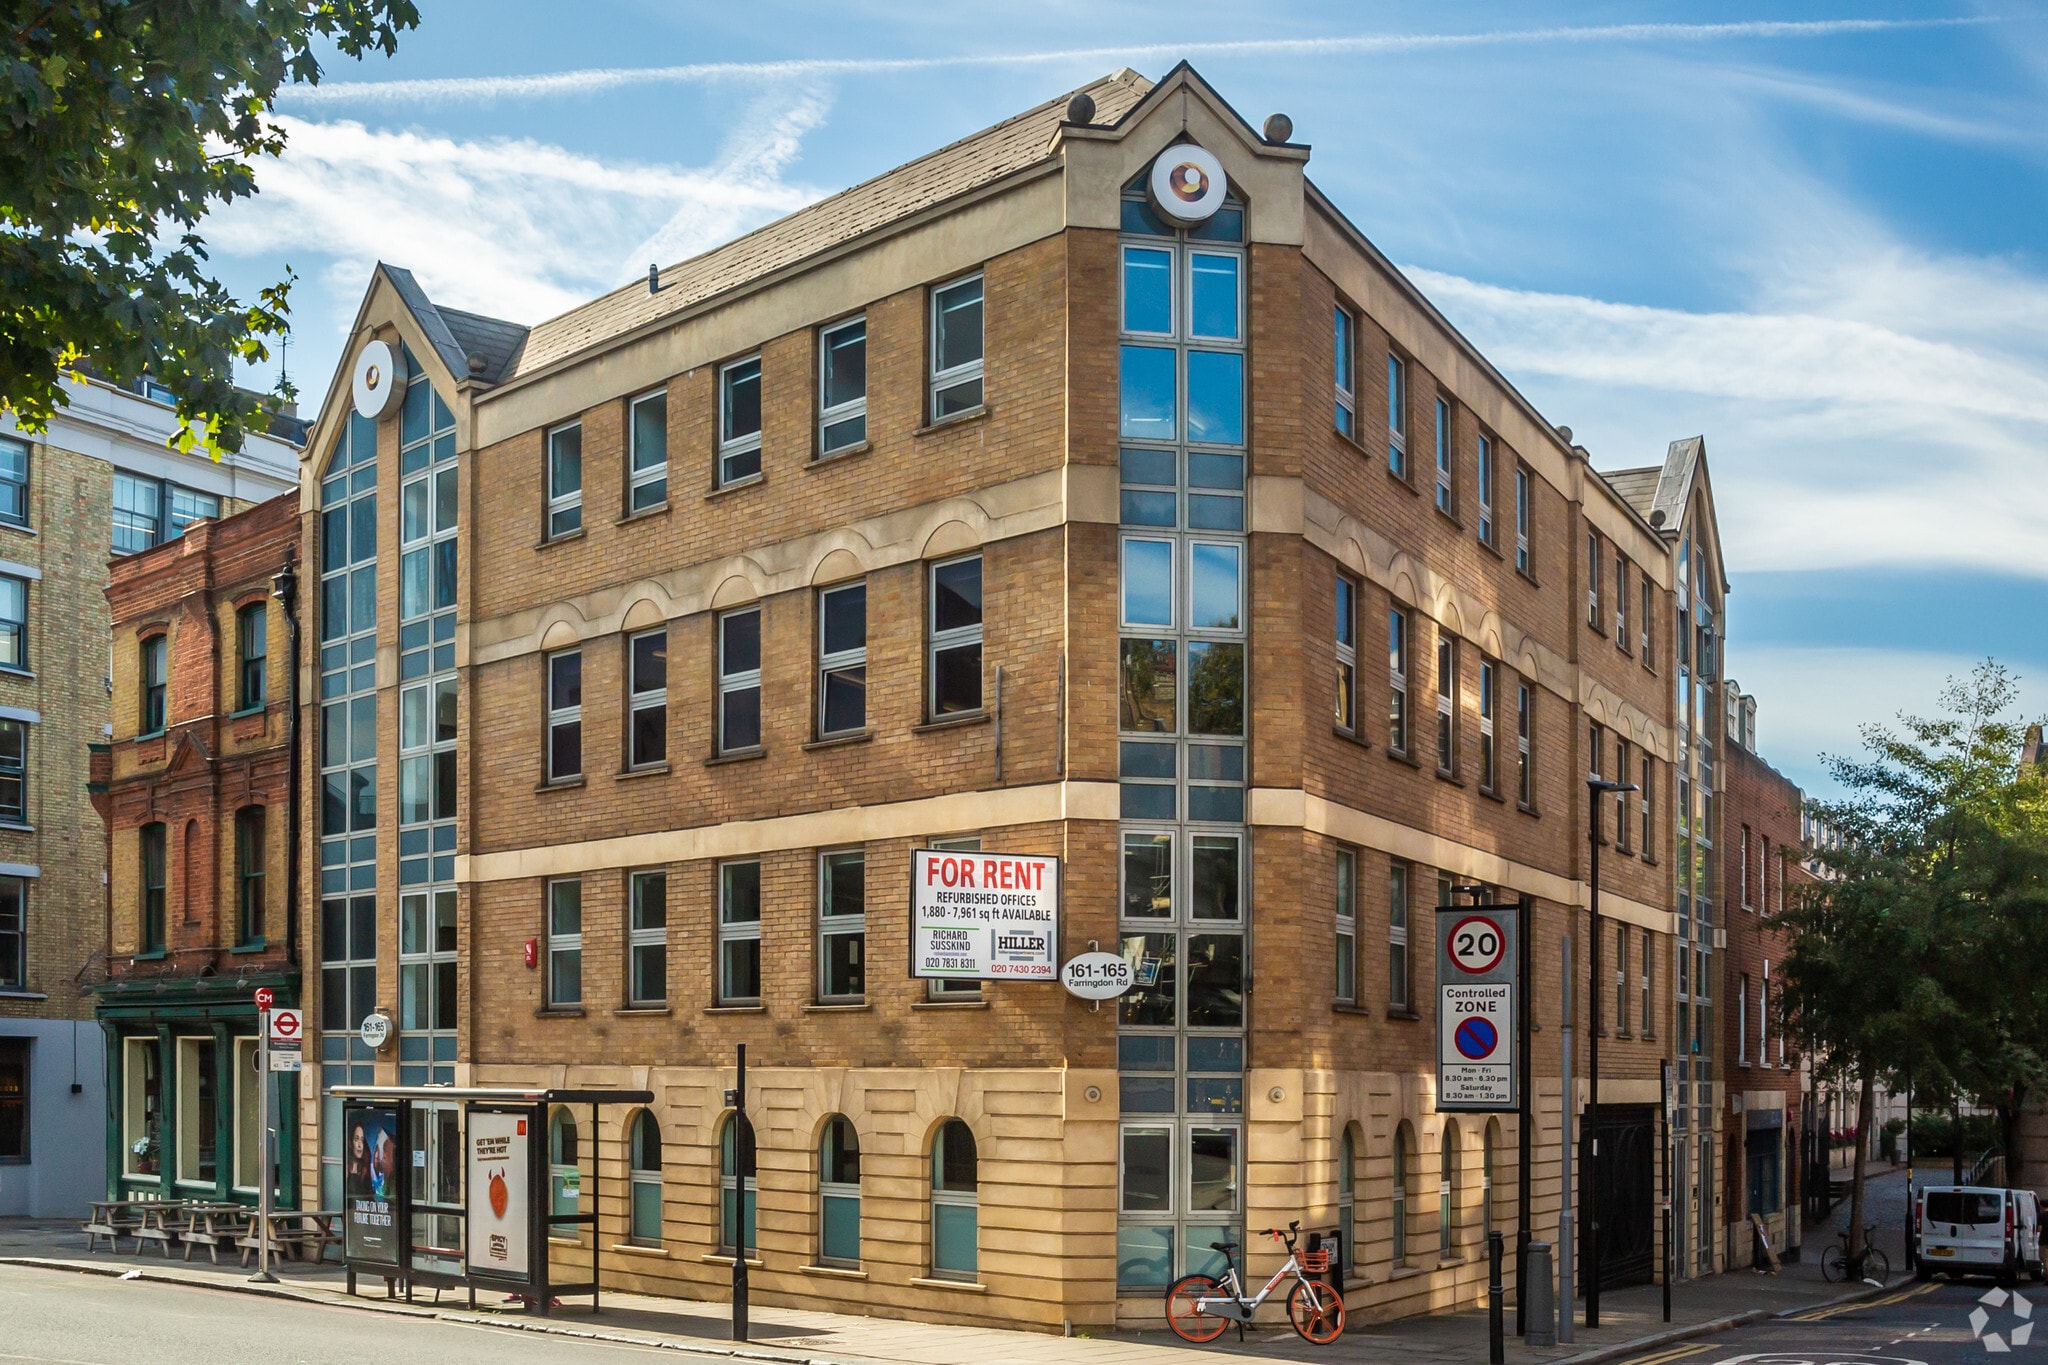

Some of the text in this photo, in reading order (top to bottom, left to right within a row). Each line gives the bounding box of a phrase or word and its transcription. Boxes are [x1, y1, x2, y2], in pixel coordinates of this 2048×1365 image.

[927, 857, 1046, 891] FOR RENT
[936, 891, 1036, 907] REFURBISHED OFFICES
[921, 905, 946, 919] 1,880
[953, 907, 977, 920] 7,961
[979, 911, 990, 923] sq
[992, 908, 1000, 920] ft
[1002, 908, 1052, 922] AVAILABLE
[932, 930, 968, 941] RICHARD
[930, 940, 971, 951] SUSSKIND
[997, 936, 1045, 951] HILLER
[1457, 932, 1498, 957] 20
[925, 957, 976, 969] 020 7831 8311
[991, 964, 1052, 975] 020 7430 2394
[1068, 963, 1128, 979] 161-165
[1068, 979, 1128, 988] Farringdon Rd
[257, 993, 273, 1003] CM
[1446, 988, 1506, 999] Controlled
[1455, 1001, 1497, 1013] ZONE
[363, 1021, 385, 1032] 161-165
[497, 1146, 507, 1154] HOT
